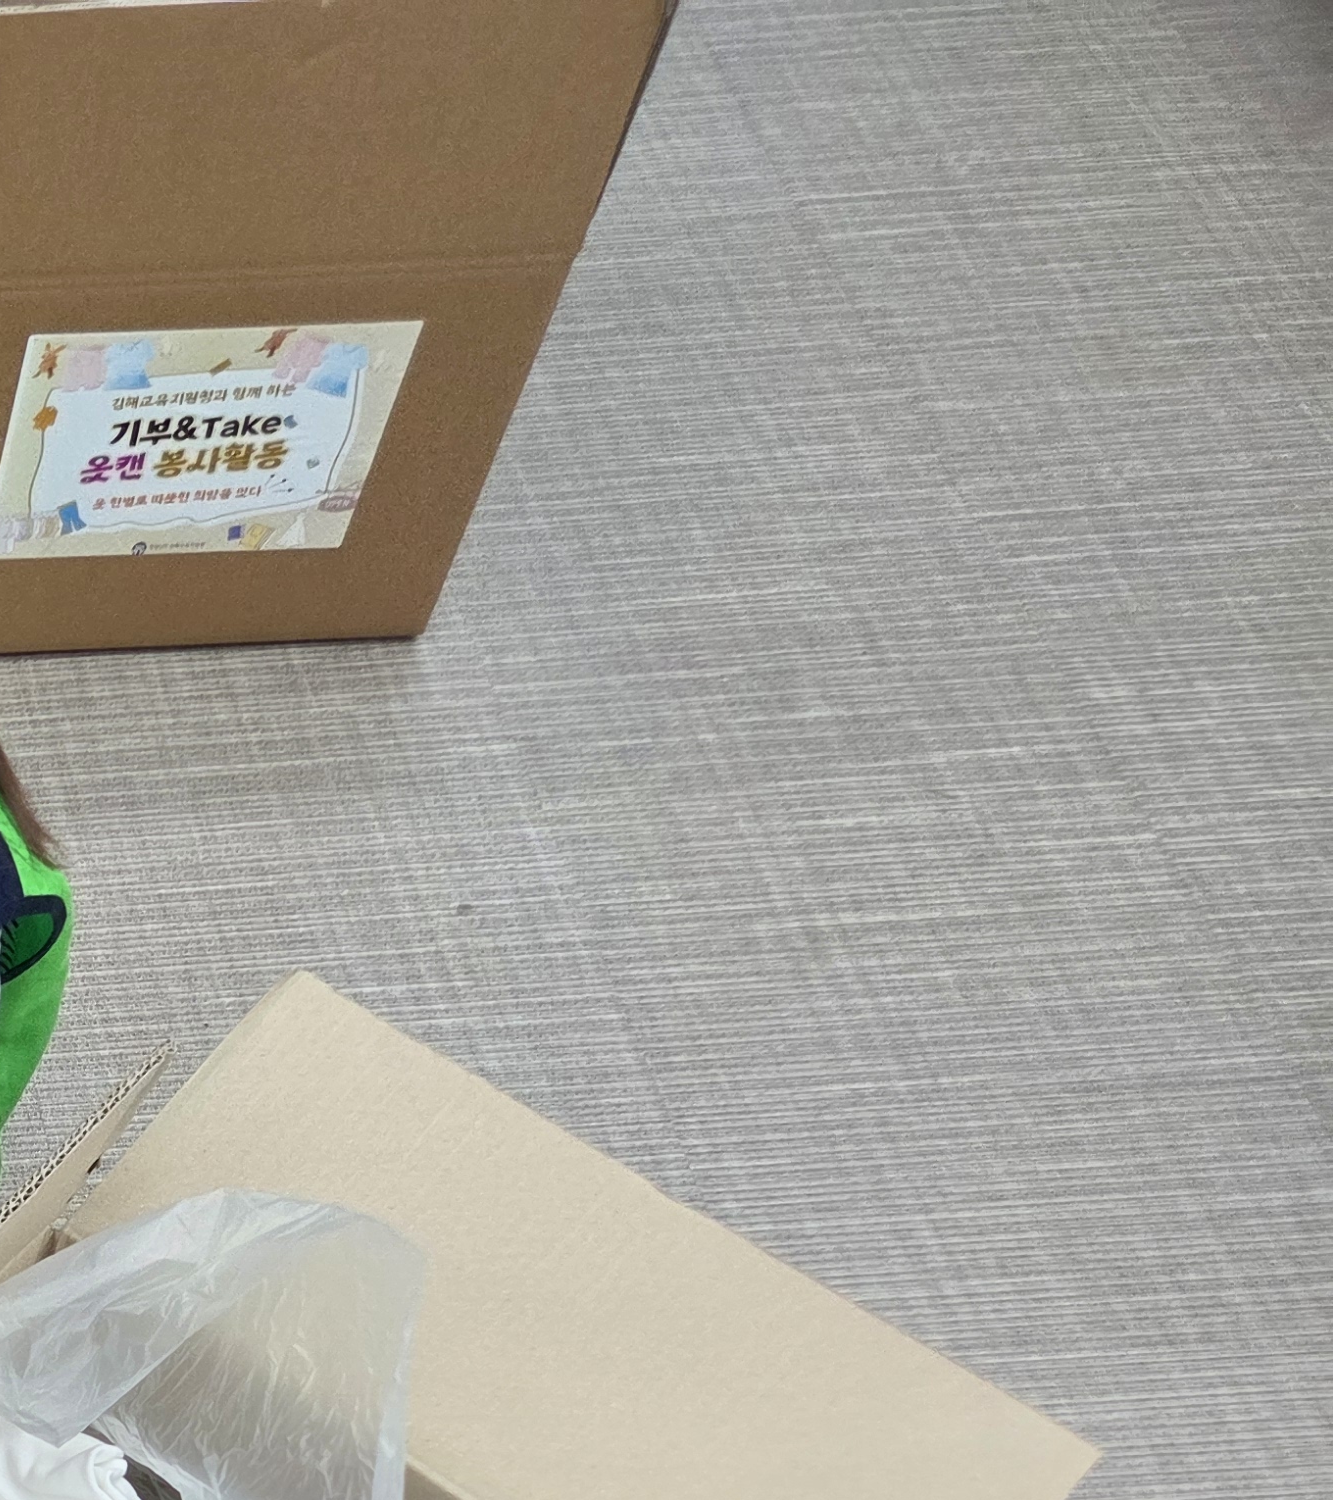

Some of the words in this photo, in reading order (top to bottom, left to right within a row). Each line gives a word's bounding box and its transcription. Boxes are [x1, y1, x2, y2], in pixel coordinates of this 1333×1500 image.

[110, 415, 282, 447] 기부&Take
[80, 451, 146, 484] 옷캔
[153, 439, 289, 478] 봉사활동
